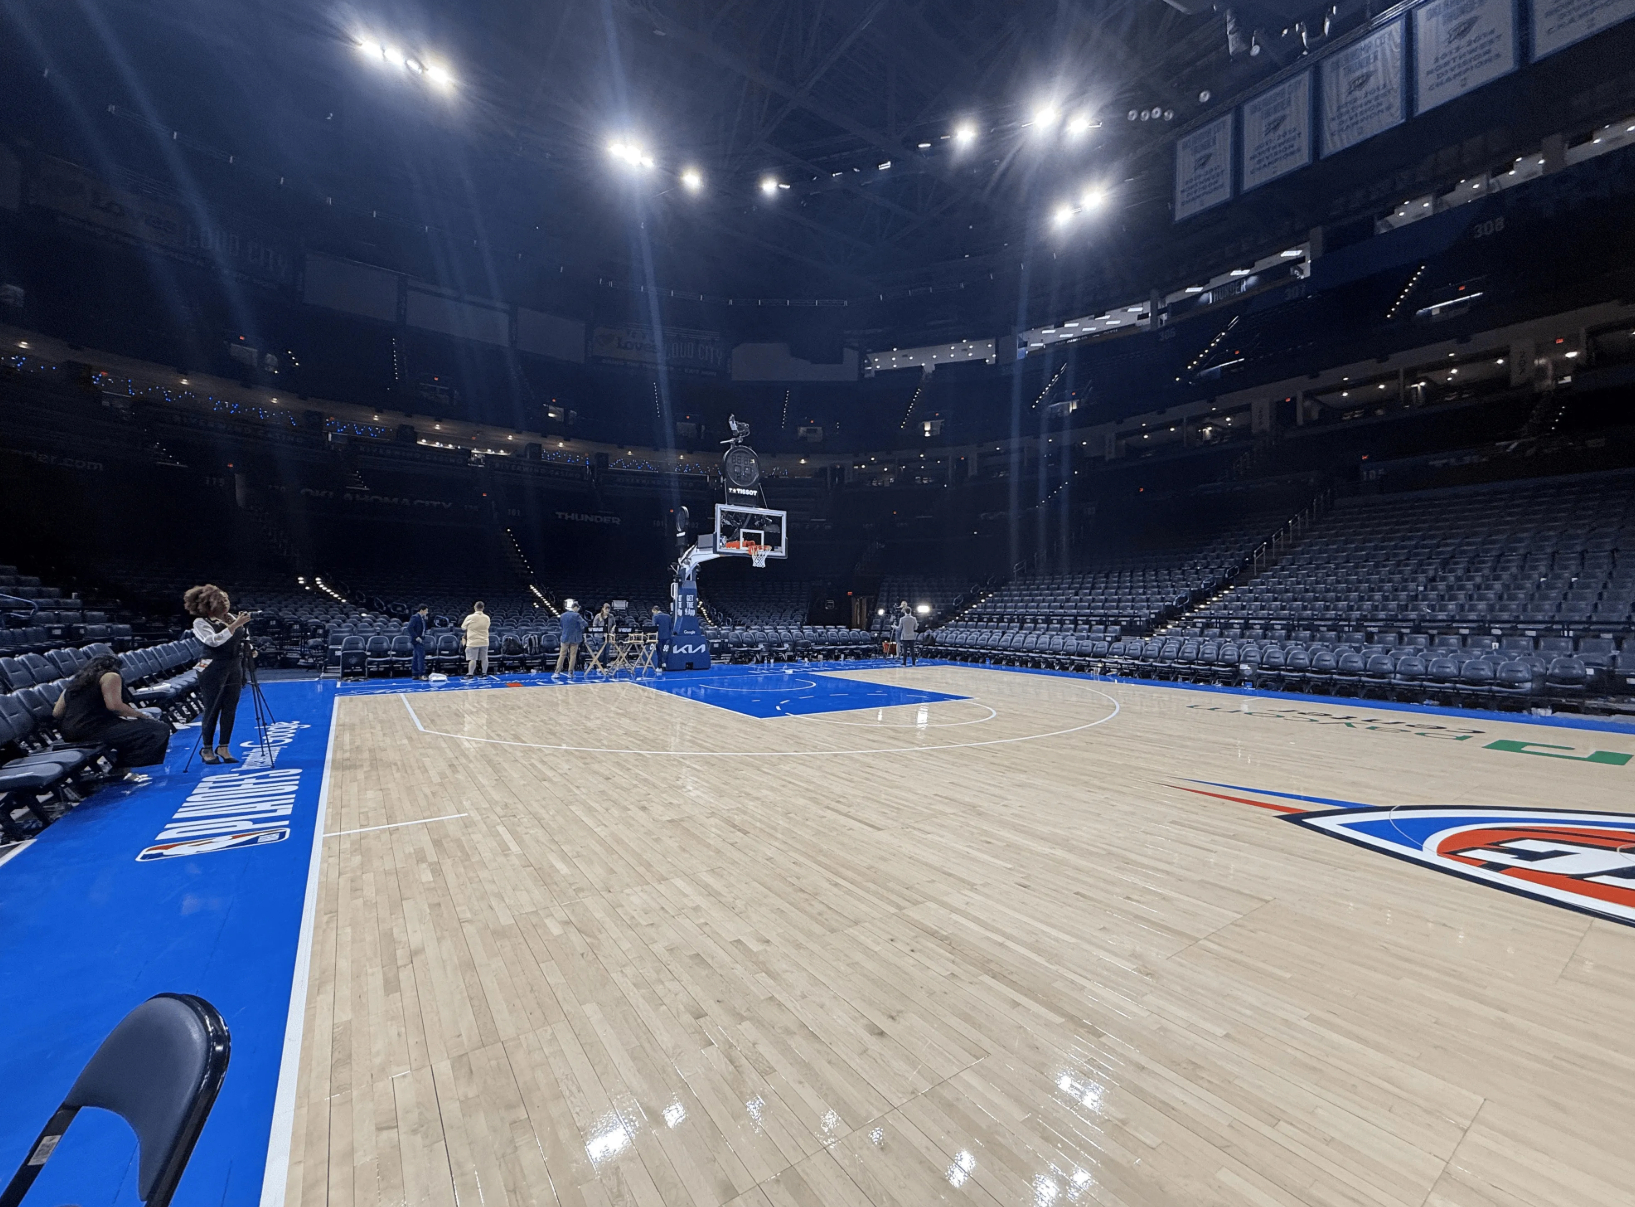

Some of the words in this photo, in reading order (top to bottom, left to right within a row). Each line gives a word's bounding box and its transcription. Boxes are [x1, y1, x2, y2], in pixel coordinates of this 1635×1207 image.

[1426, 33, 1502, 77] NORTHWEST
[1428, 50, 1501, 93] CHAMPIONS
[1436, 47, 1490, 80] DIVISION
[1473, 216, 1505, 239] 308
[555, 511, 622, 525] THUNDER
[1186, 703, 1473, 742] paycom
[1268, 708, 1486, 734] center
[155, 768, 303, 841] PLAYOFFS
